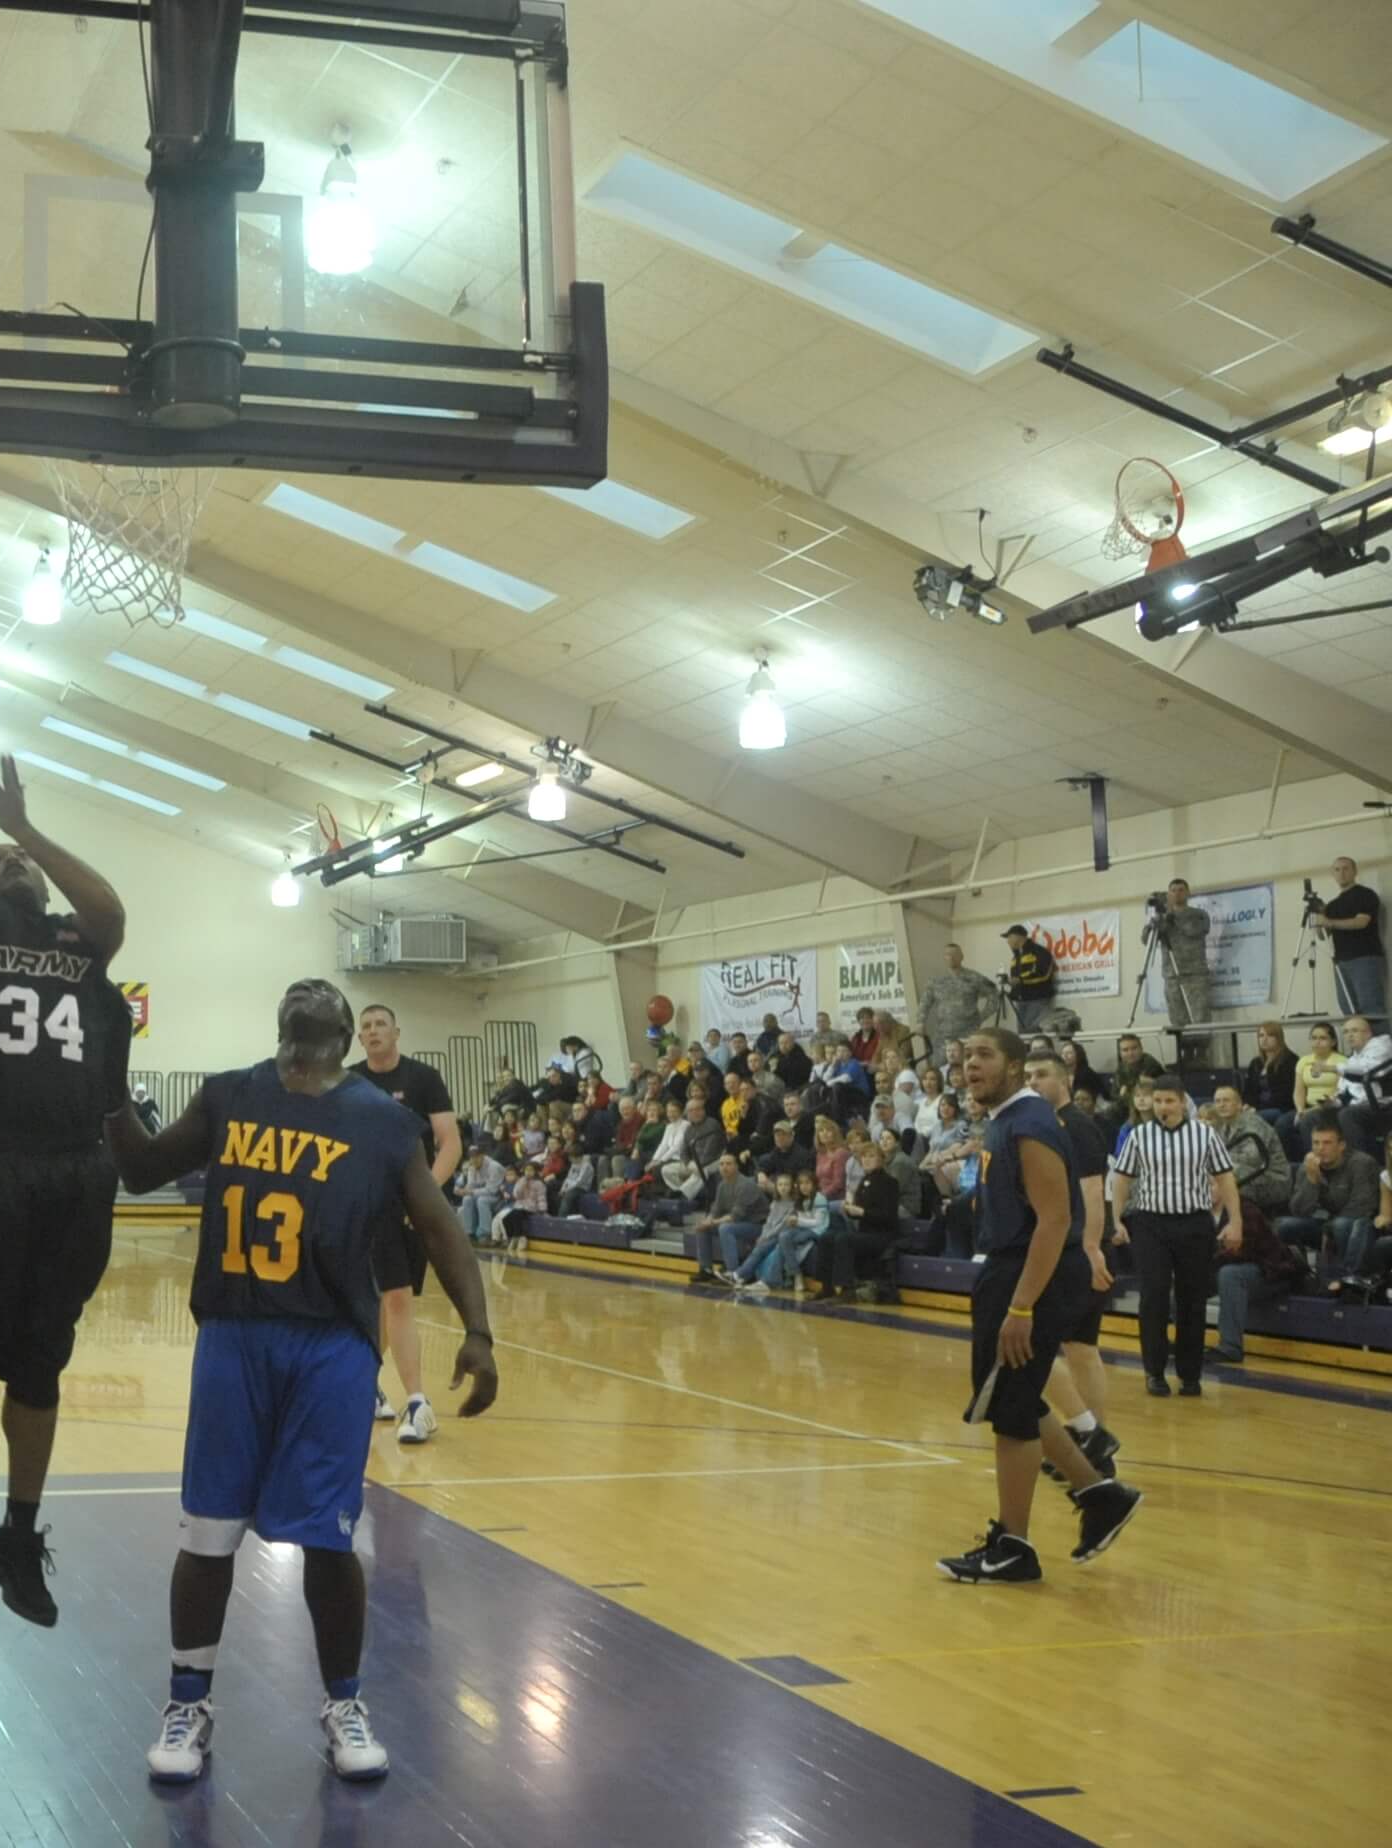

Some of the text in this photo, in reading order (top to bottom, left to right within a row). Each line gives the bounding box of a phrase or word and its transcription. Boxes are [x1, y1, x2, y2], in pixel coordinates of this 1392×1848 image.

[721, 953, 798, 990] REAL FIT
[219, 1120, 351, 1182] NAVY
[222, 1184, 304, 1283] 13
